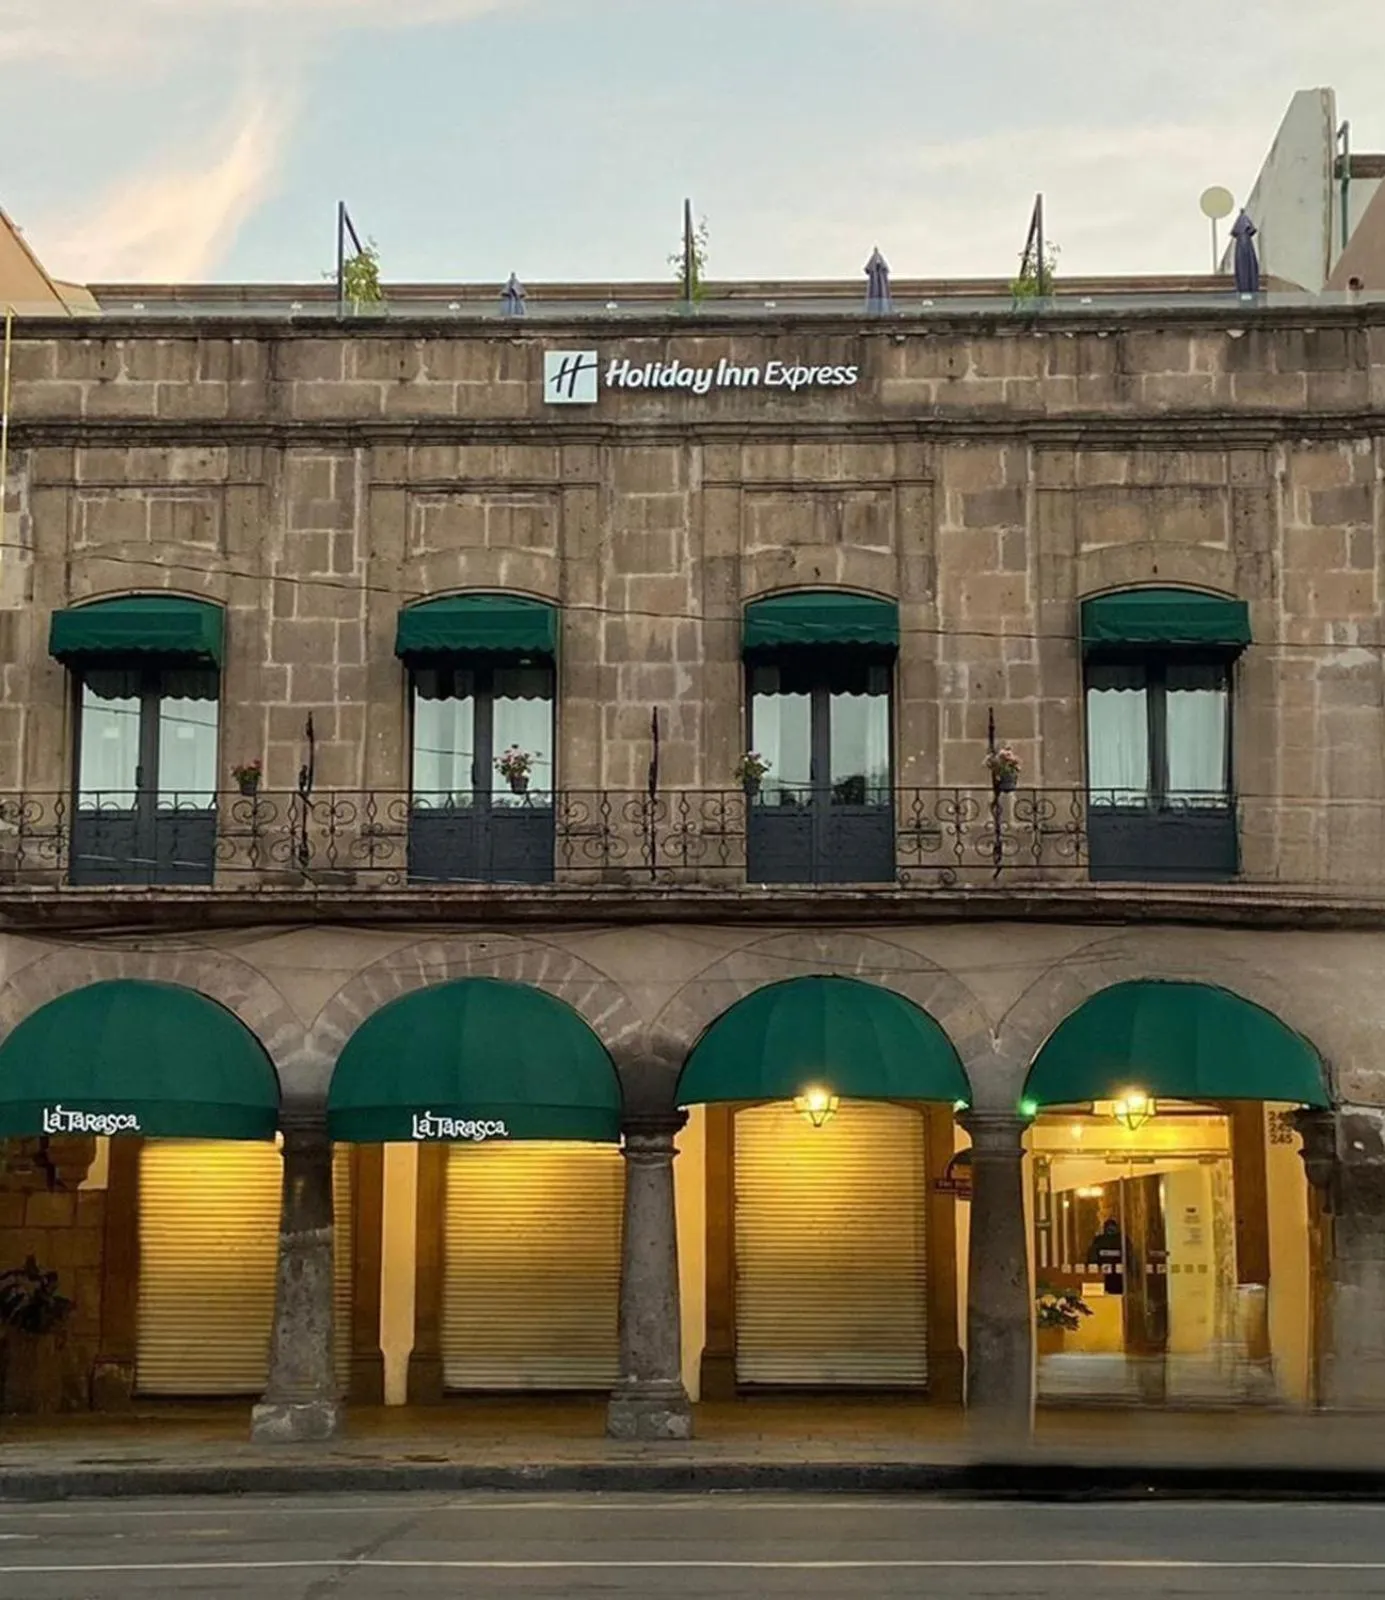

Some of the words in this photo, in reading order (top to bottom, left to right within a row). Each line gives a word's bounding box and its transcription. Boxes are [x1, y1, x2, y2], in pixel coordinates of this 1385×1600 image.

[605, 359, 714, 394] Holiday
[716, 358, 759, 387] Inn
[763, 361, 858, 391] Express
[43, 1108, 66, 1133] La
[412, 1114, 435, 1139] La
